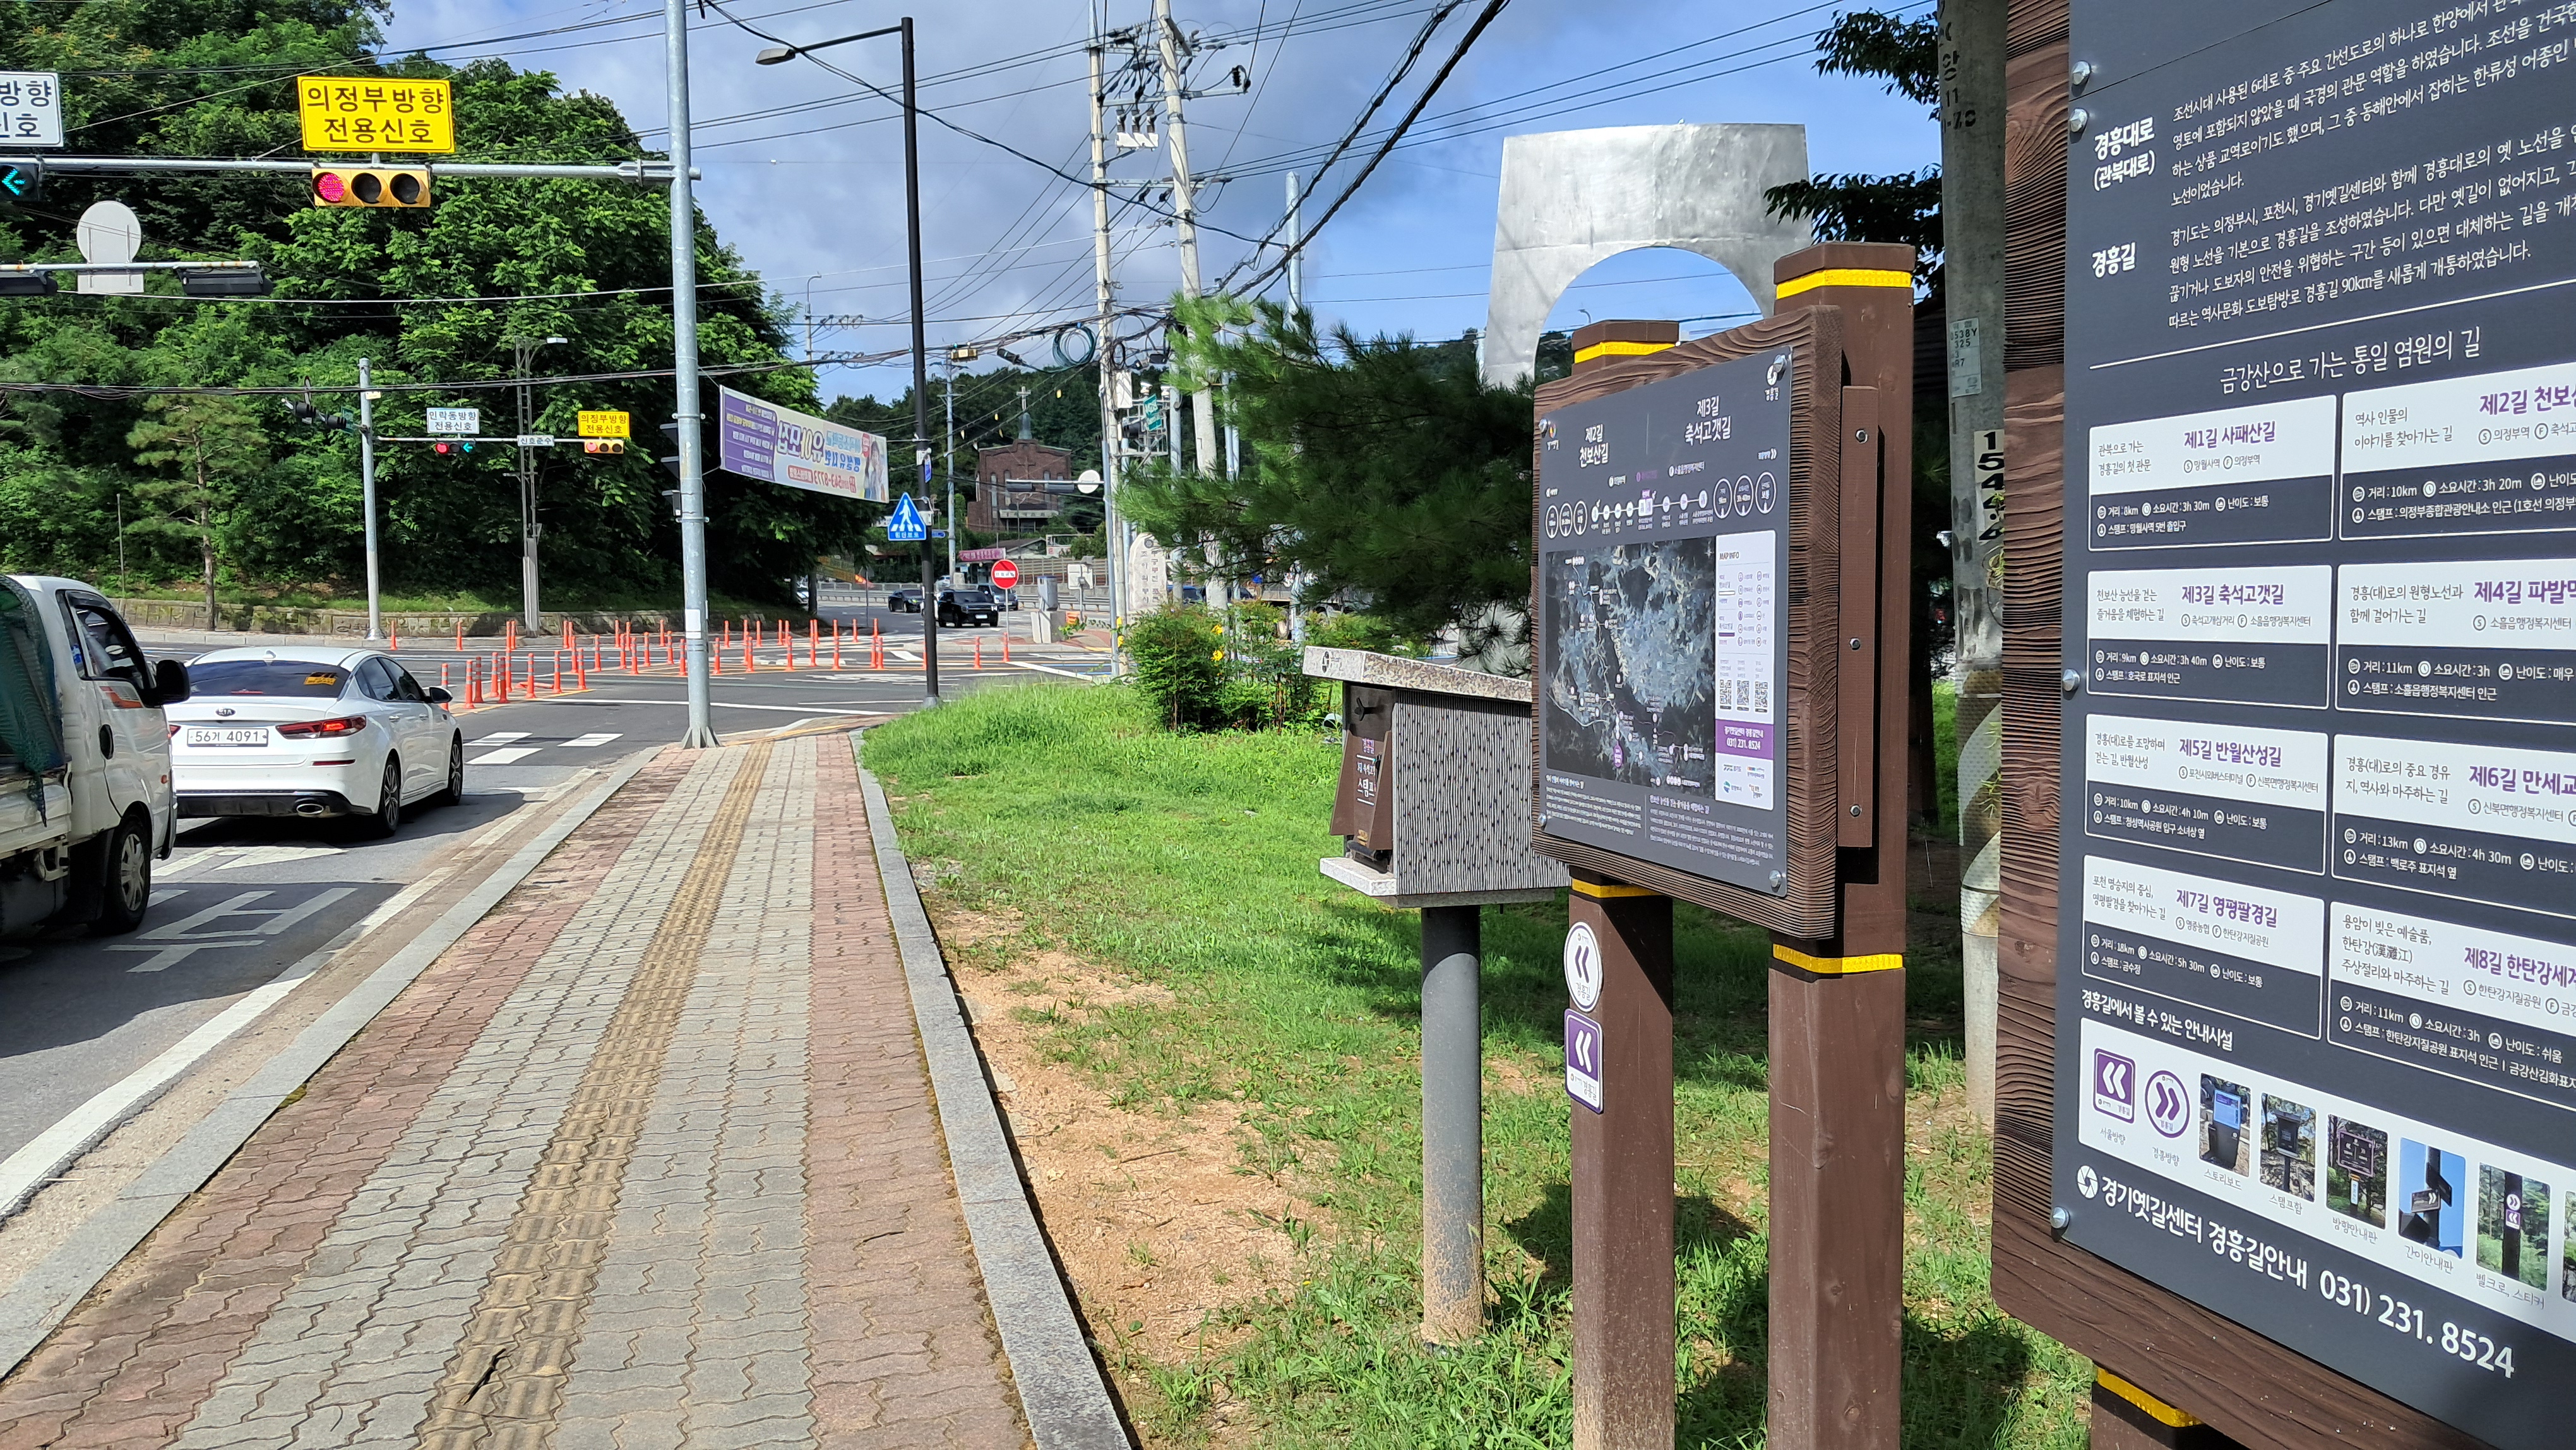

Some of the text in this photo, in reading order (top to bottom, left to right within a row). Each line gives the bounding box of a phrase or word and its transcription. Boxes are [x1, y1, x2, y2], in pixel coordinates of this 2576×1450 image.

[2173, 1, 2488, 122] 조선시대 사용된 6대로 중 주요 간선도로의 하나로 한양에서
[307, 83, 445, 114] 의정부방향
[323, 117, 434, 144] 전용신호
[2094, 117, 2154, 160] 경흥대로
[2093, 150, 2155, 191] (관북대로)
[2171, 127, 2565, 246] 경기도는 의정부시, 포천시, 경기옛길센터와 함께 경흥대로의 옛 노선을
[2171, 171, 2245, 207] 노선이었습니다.
[2091, 241, 2137, 278] 경흥길
[2169, 239, 2531, 329] 따르는 역사문화 도보탐방로 경흥길 90km를 새롭게 개통하였습니다.
[1954, 338, 1971, 349] 325
[2221, 327, 2481, 395] 금강산으로 가는 통일 염원의 길
[1696, 395, 1720, 417] 제3길
[2480, 390, 2527, 415] 제2길
[429, 411, 476, 421] 민락동방향
[434, 421, 472, 431] 전용신호
[581, 414, 627, 424] 의정부방향
[2356, 407, 2408, 427] 역사 인물의
[586, 424, 623, 434] 전용신호
[1585, 423, 1604, 443] 제2길
[1685, 415, 1732, 446] 축석고갯길
[2184, 421, 2275, 449] 제1길 사패산길
[2354, 426, 2453, 450] 이야기를 찾아가는 길
[2493, 426, 2530, 441] 의정부역
[1579, 443, 1609, 468] 천보산길
[2098, 440, 2144, 457] 관북으로 가는
[2099, 459, 2151, 476] 경흥길의 첫 관문
[2234, 455, 2260, 466] 의정부역
[2499, 477, 2522, 490] 20m
[2097, 589, 2157, 601] 천보산 능선을 걷는
[2182, 584, 2284, 605] 제3길 축석고갯길
[2351, 584, 2464, 601] 경흥(대)로의 원형노선과
[2474, 581, 2522, 604] 제4길
[2097, 608, 2164, 622] 즐거움을 체험하는 길
[2350, 608, 2426, 623] 함께 걸어가는 길
[2490, 617, 2572, 630] 소흘읍행정복지센터
[227, 731, 258, 742] 4091
[2135, 737, 2165, 751] 조망하며
[2095, 752, 2148, 769] 걷는 길, 반월산성
[2179, 739, 2281, 768] 제5길 반월산성길
[2346, 756, 2450, 781] 경흥(대)로의 중요 경유
[2469, 765, 2517, 793] 제6길
[2346, 779, 2448, 805] 지, 역사와 마주하는 길
[2483, 801, 2563, 822] 신북면행정복지센터
[2488, 851, 2512, 865] 30m
[2419, 862, 2457, 880] 표지석 옆
[2092, 876, 2154, 899] 포천 명승지의 중심,
[2127, 902, 2157, 918] 찾아가는
[2159, 908, 2166, 921] 길
[2176, 889, 2277, 928] 제7길 영평팔경길
[2343, 914, 2431, 945] 용암이 빚은 예술품,
[2464, 947, 2501, 975] 제8길
[2342, 959, 2449, 995] 주상절리와 마주하는 길
[2479, 985, 2541, 1009] 한탄강지질공원
[2082, 989, 2233, 1052] 경흥길에서 볼 수 있는 안내시설
[2204, 1168, 2241, 1190] 스토리보드
[2270, 1193, 2302, 1215] 스탬프함
[2332, 1216, 2378, 1244] 방향안내판
[2404, 1245, 2454, 1274] 간이안내판
[2102, 1177, 2515, 1379] 경기옛길센터 경흥길안내 031) 231. 8524
[2476, 1273, 2545, 1310] 벨크로, 스티커
